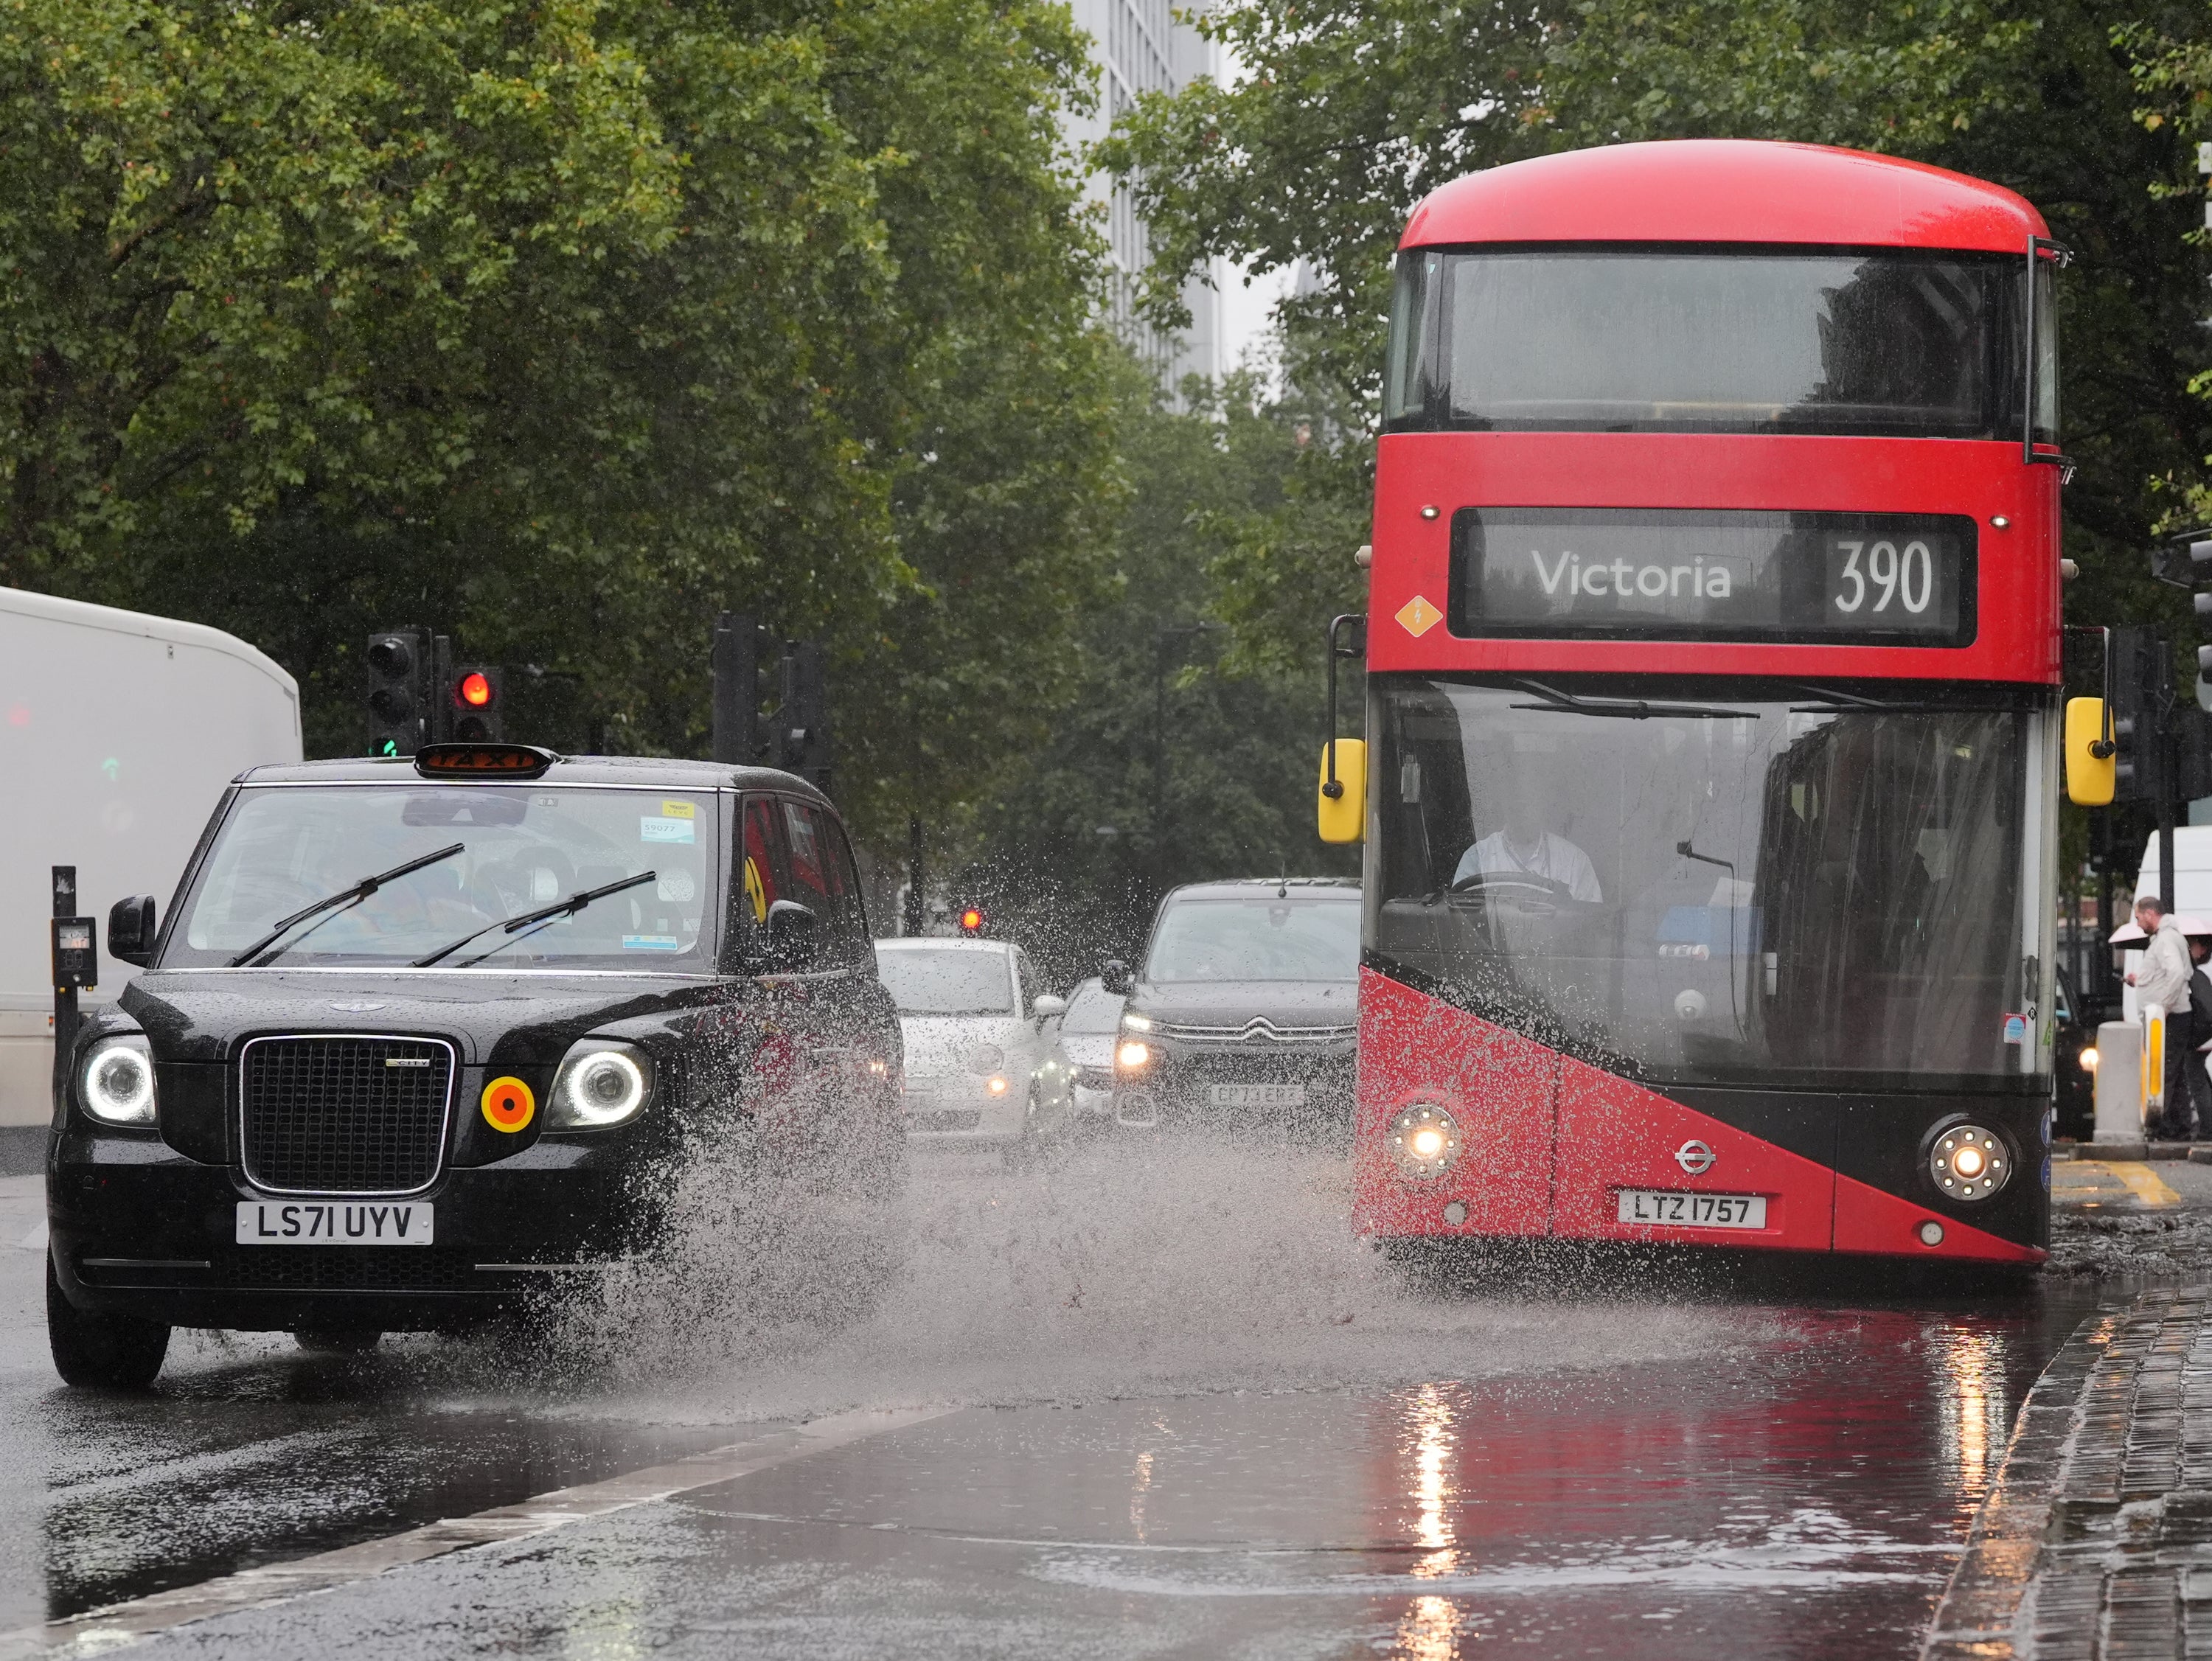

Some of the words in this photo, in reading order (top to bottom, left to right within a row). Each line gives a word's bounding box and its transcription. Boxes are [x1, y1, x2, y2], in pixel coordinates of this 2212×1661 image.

[1531, 550, 1731, 598] Victoria
[1834, 540, 1933, 613] 390
[438, 752, 525, 766] TAXI
[2030, 1009, 2035, 1018] R
[258, 1206, 334, 1236] LS71
[345, 1206, 412, 1237] UYV
[1635, 1195, 1684, 1219] LTZ
[1692, 1197, 1750, 1222] 1757
